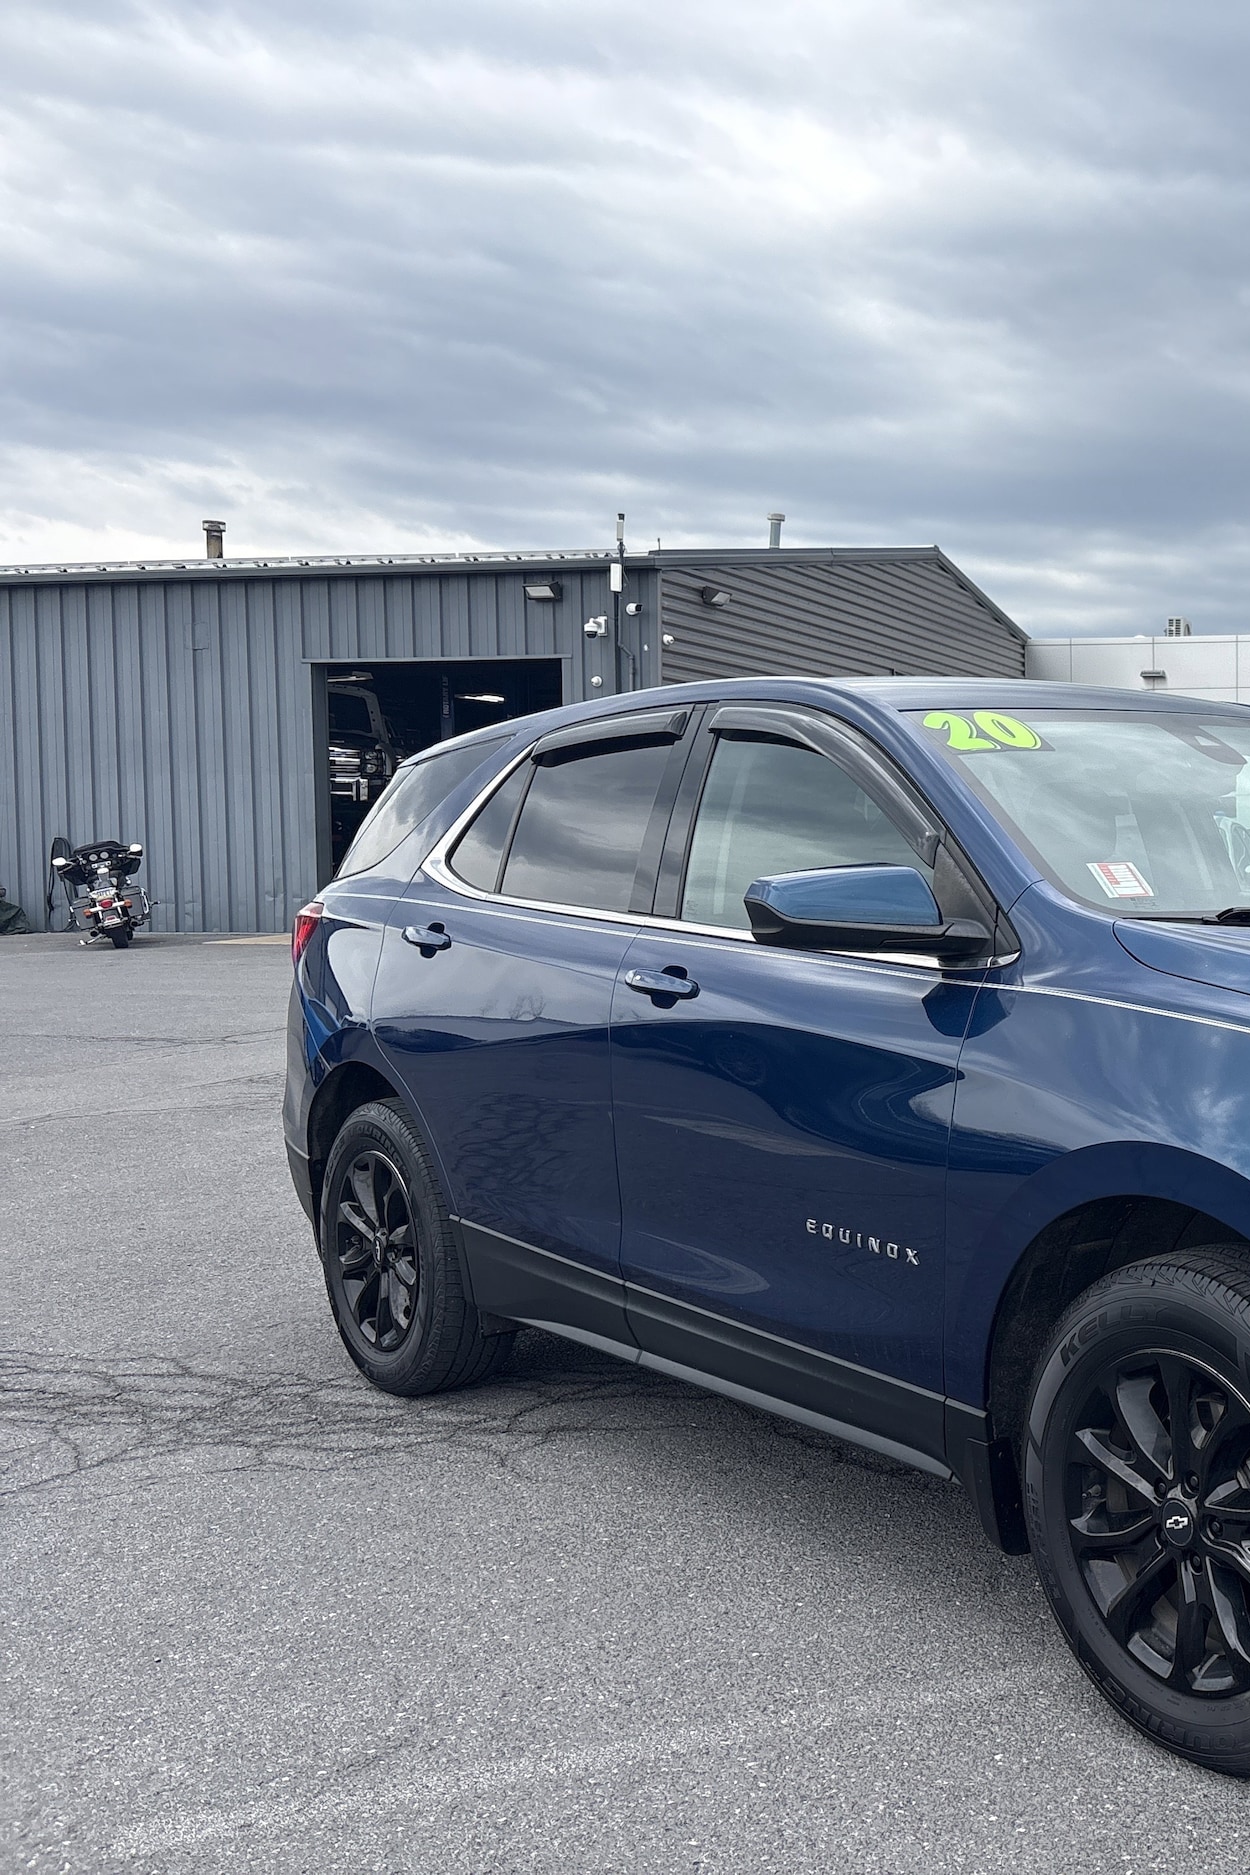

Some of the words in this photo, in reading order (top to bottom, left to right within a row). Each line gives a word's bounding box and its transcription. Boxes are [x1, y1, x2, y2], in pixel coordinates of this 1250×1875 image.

[923, 711, 1042, 751] 20
[805, 1218, 920, 1266] EQUINOX
[1060, 1303, 1169, 1367] KELLY
